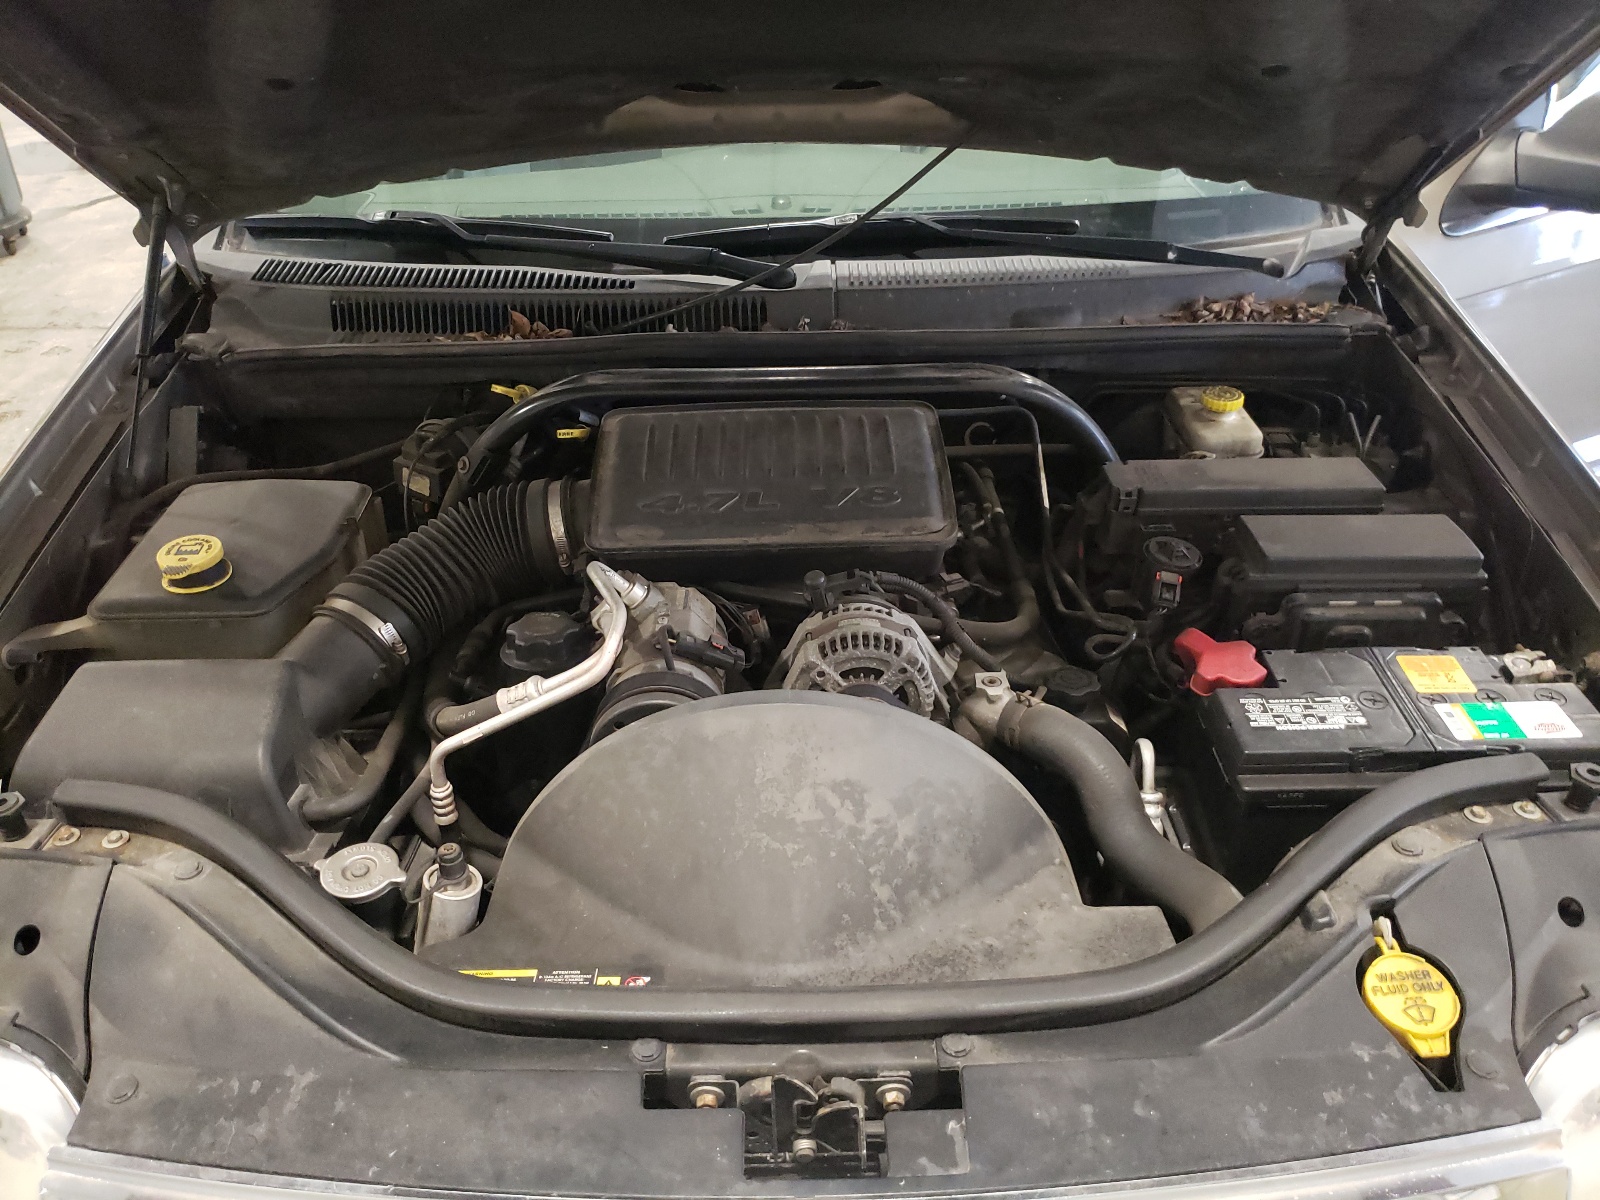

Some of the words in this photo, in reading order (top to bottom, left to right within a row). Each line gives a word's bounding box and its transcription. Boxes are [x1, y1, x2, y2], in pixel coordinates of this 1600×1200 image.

[637, 487, 781, 516] 4.7L
[811, 485, 902, 510] V8
[1375, 969, 1431, 983] WASHER
[1371, 984, 1409, 997] FLUID
[1412, 981, 1444, 994] ONLY
